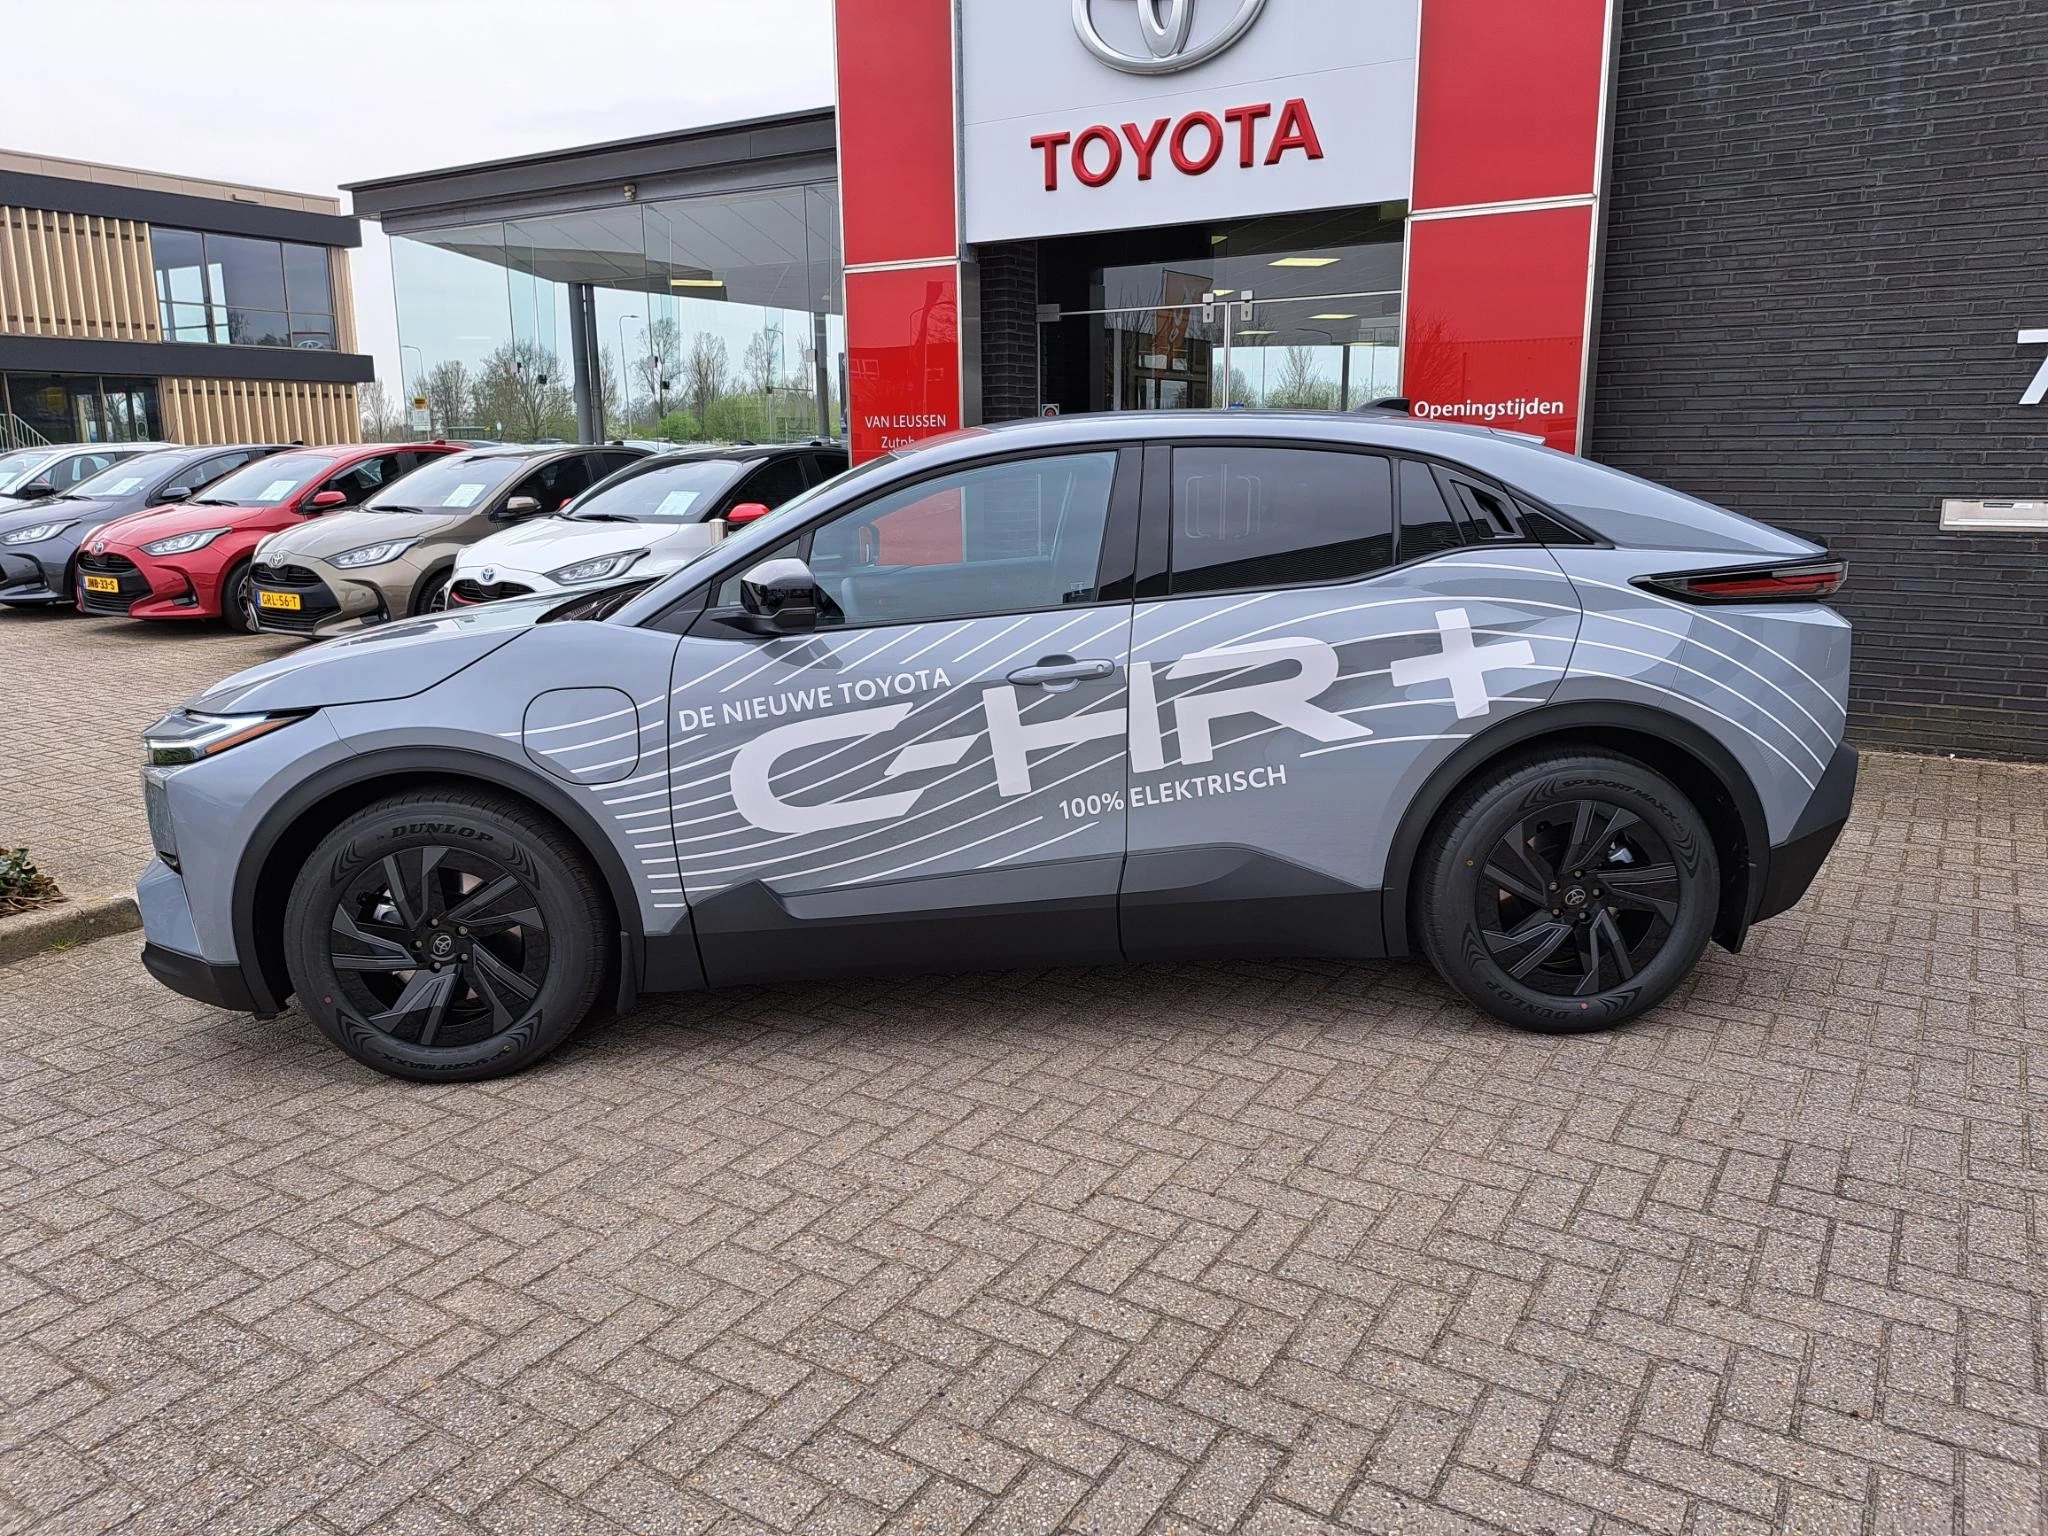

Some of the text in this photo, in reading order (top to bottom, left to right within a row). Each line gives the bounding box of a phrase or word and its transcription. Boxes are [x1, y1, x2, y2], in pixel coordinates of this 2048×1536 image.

[1030, 98, 1324, 191] TOYOTA
[865, 414, 946, 428] VAN LEUSSEN
[1414, 397, 1564, 421] Openingstijden
[262, 593, 297, 607] GRL-56-T
[678, 667, 951, 732] DE NIEUWE TOYOTA
[1058, 764, 1287, 819] 100% ELEKTRISCH
[391, 822, 495, 842] DUNLOP
